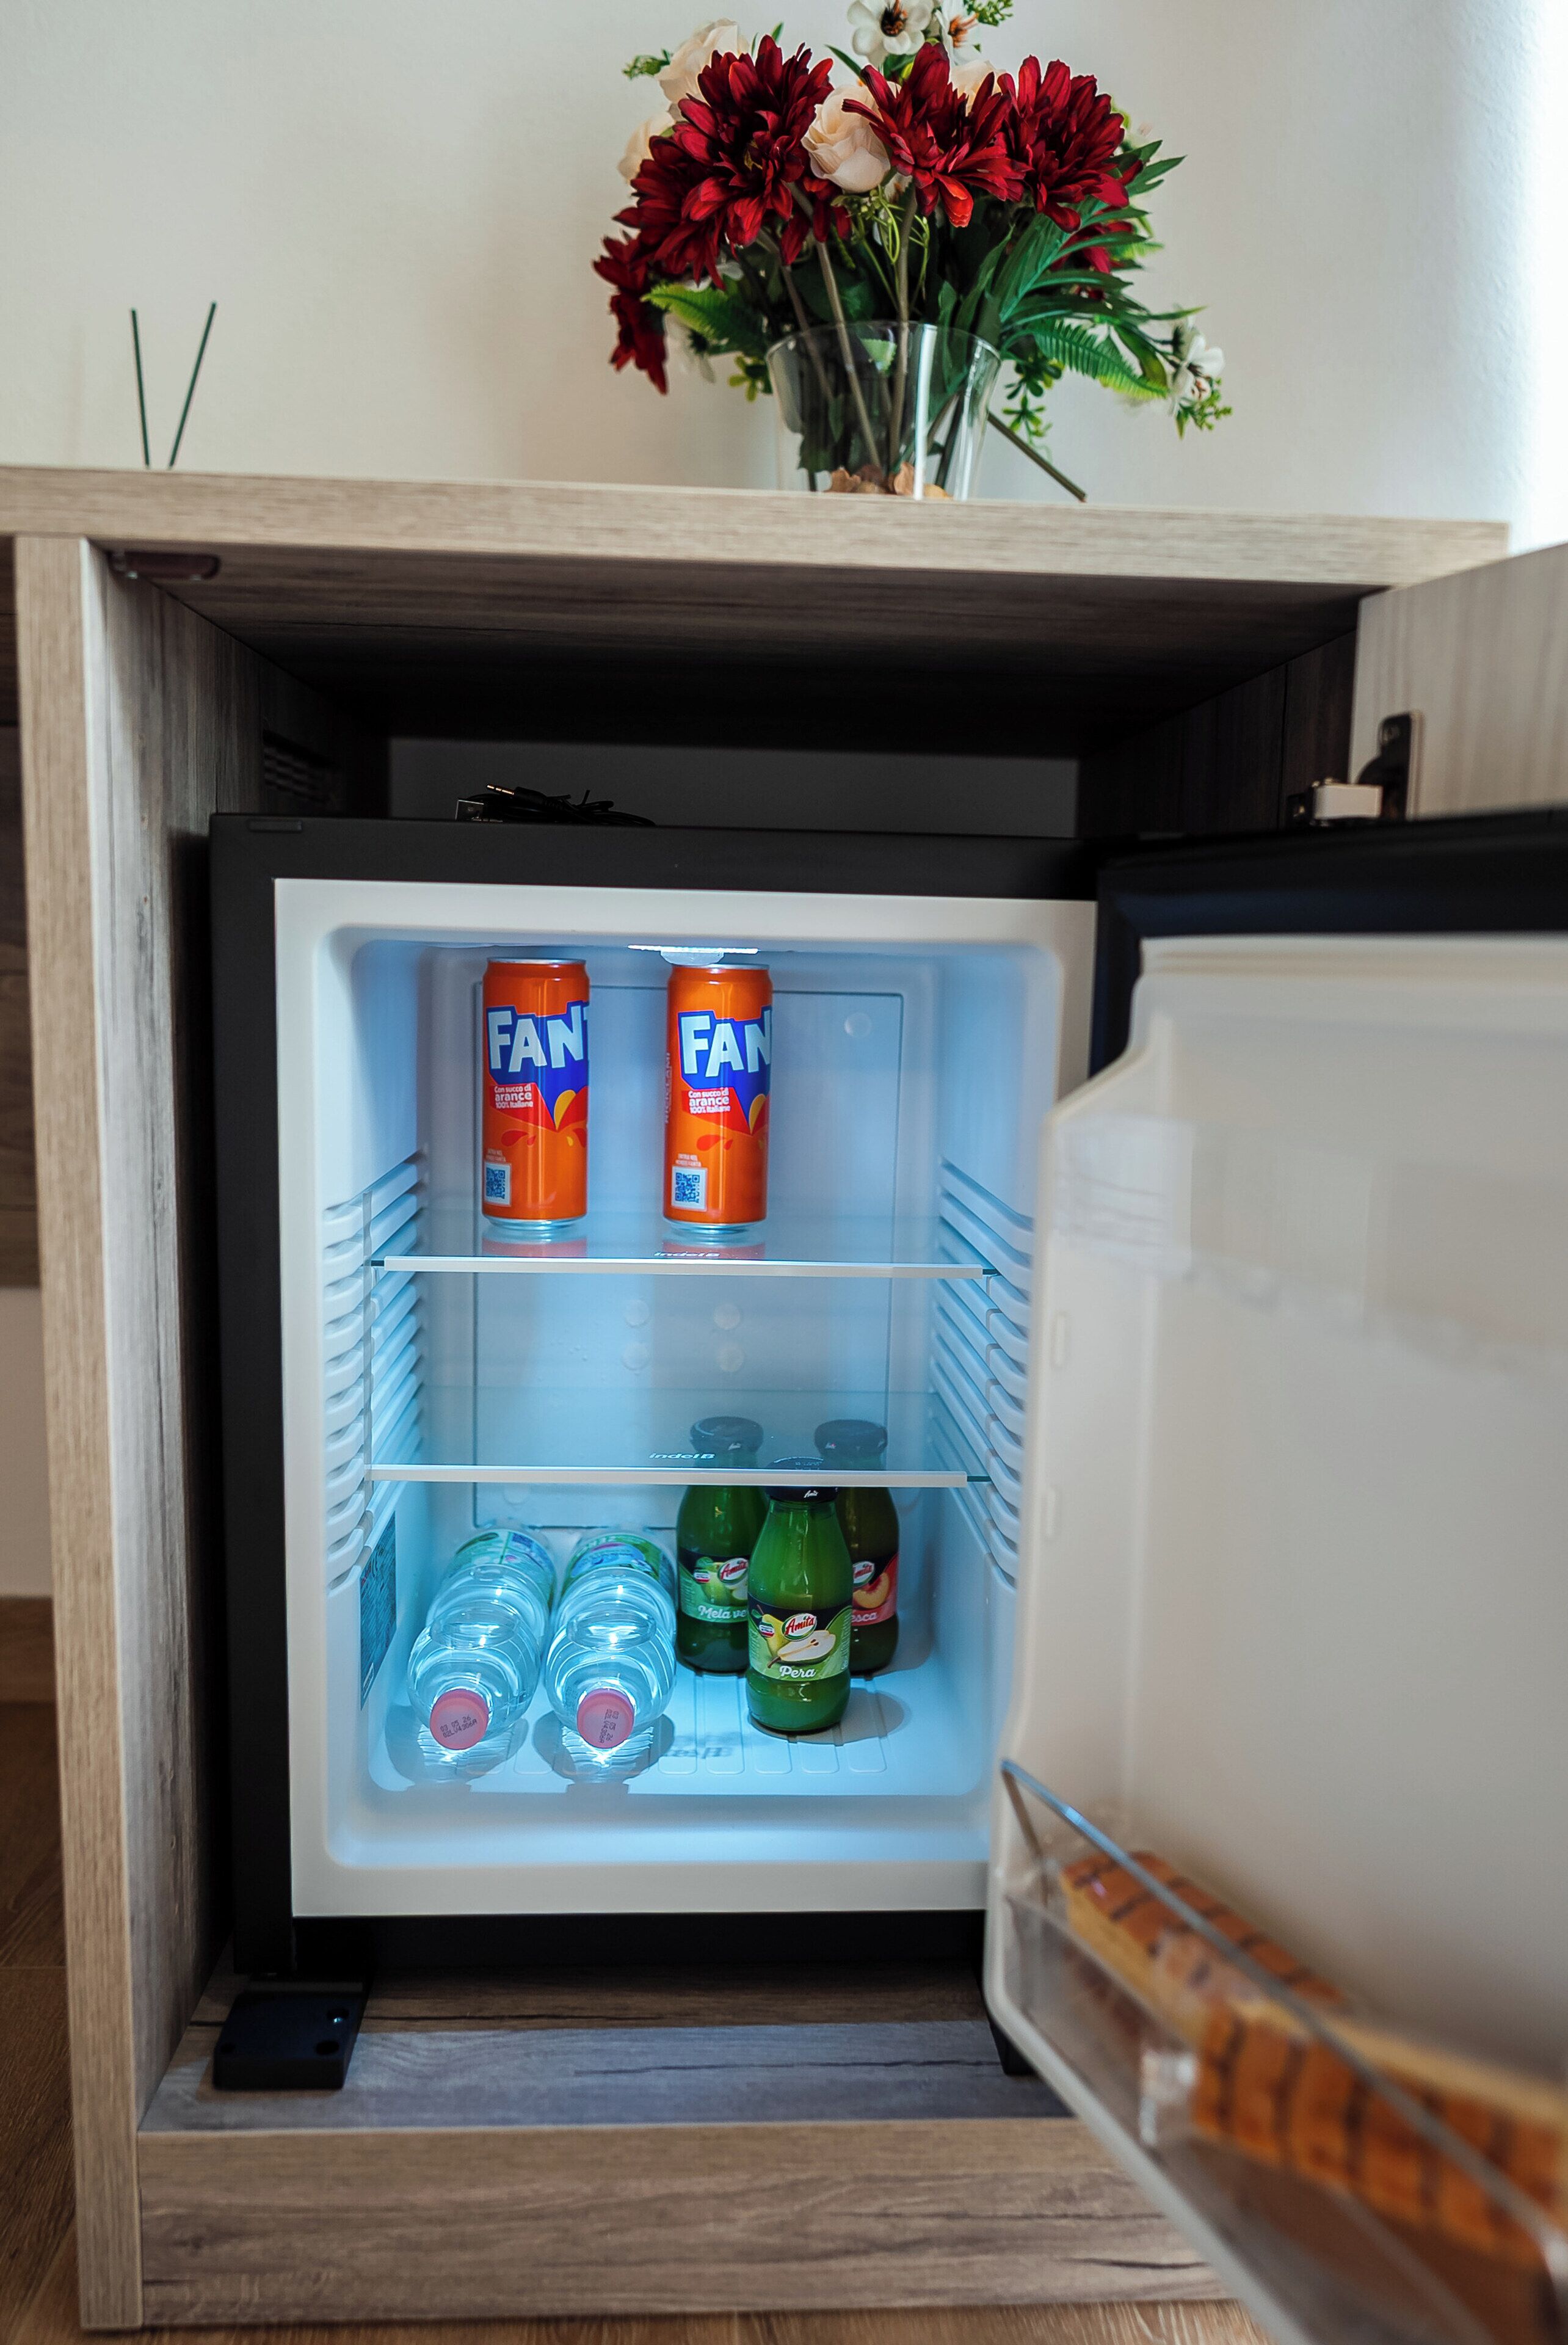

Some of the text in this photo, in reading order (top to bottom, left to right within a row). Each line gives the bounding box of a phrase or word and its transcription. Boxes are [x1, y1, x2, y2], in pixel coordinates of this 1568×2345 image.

[495, 1092, 532, 1102] arance
[689, 1096, 730, 1107] arance
[698, 1605, 732, 1619] Mela
[784, 1615, 815, 1636] Amita
[779, 1665, 817, 1678] Pera
